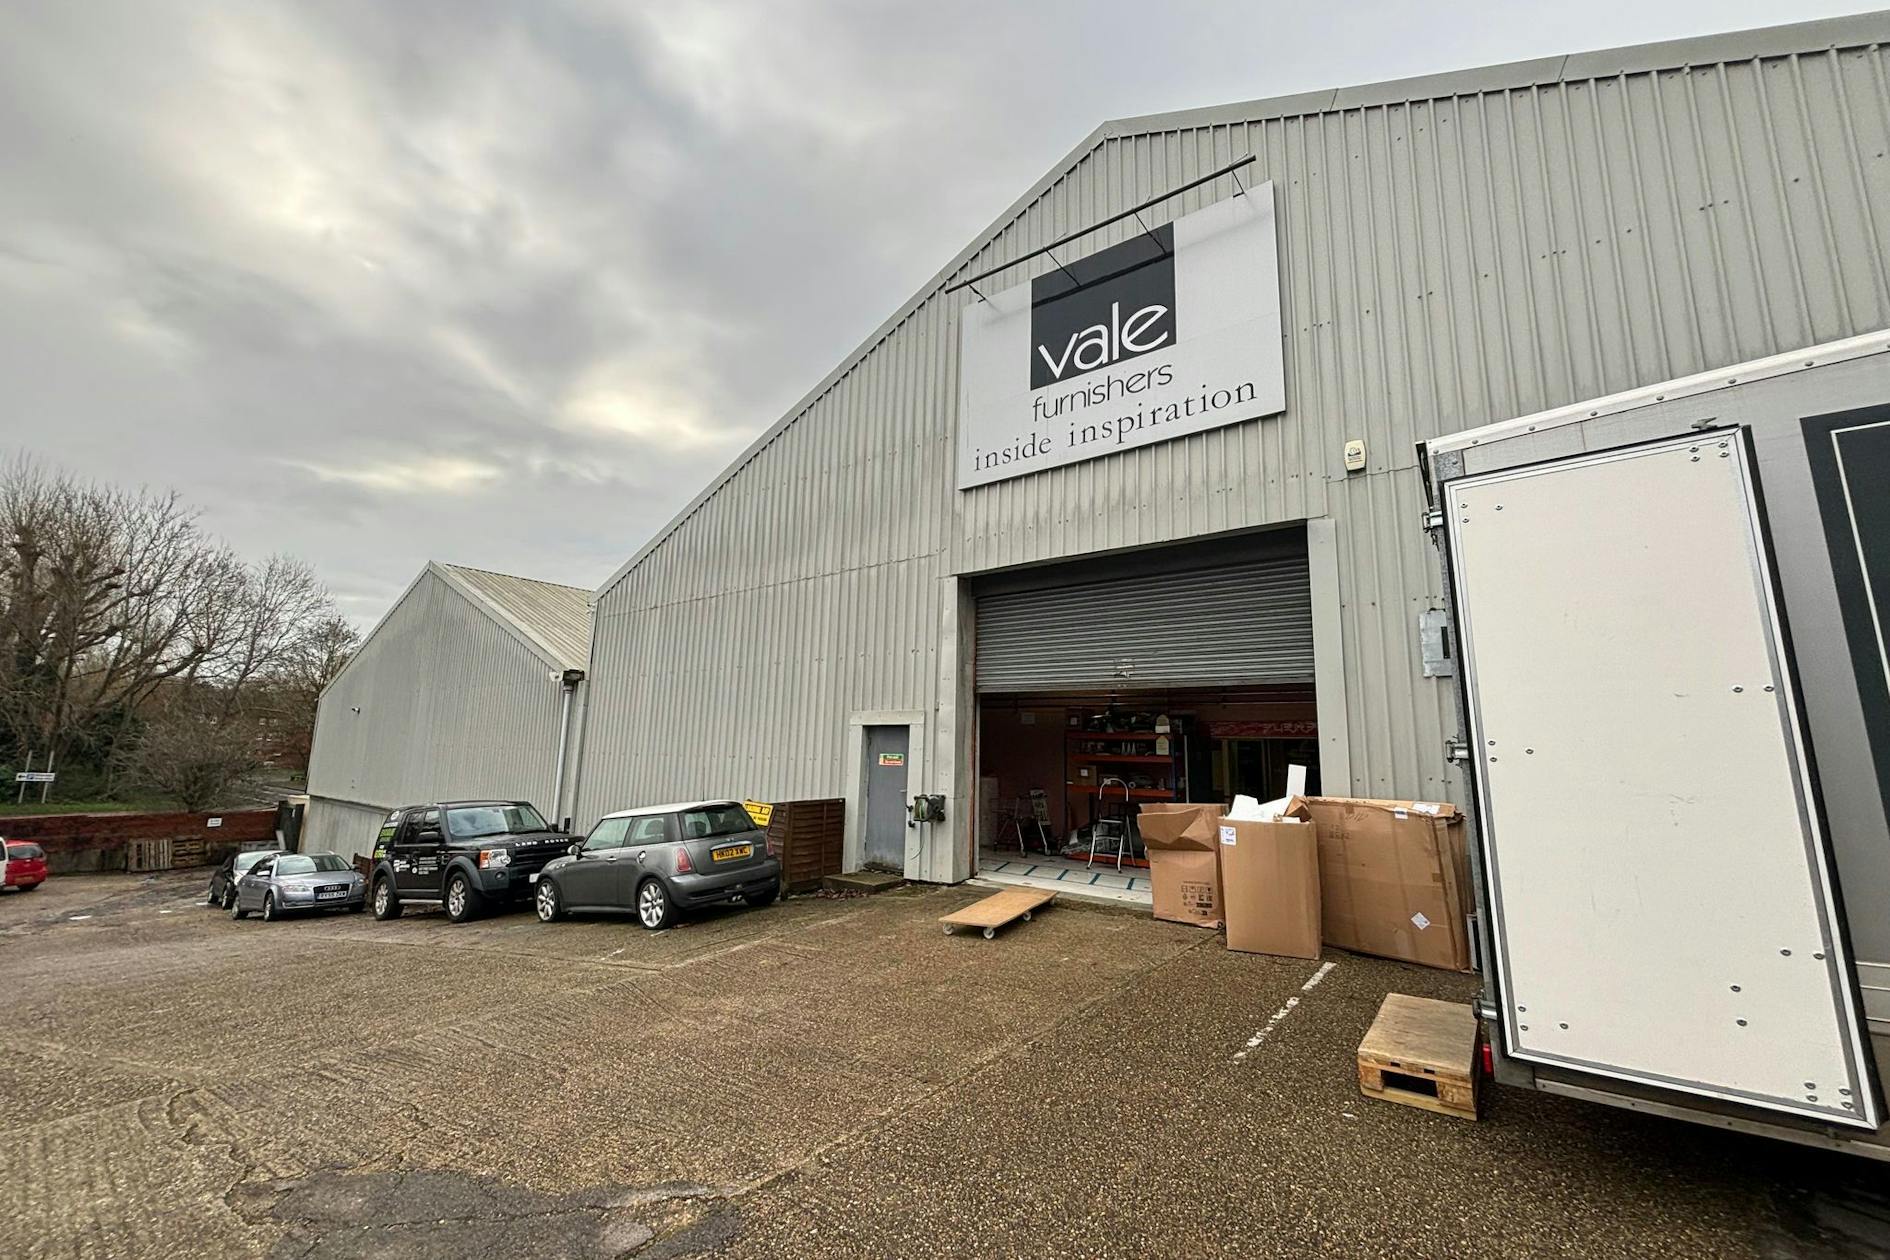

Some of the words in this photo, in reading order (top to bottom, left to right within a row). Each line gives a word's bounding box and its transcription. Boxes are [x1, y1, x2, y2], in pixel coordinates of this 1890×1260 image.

[1038, 301, 1168, 379] vale
[973, 432, 1051, 472] inside
[1069, 380, 1257, 447] inspiration
[1032, 363, 1173, 422] furnishers
